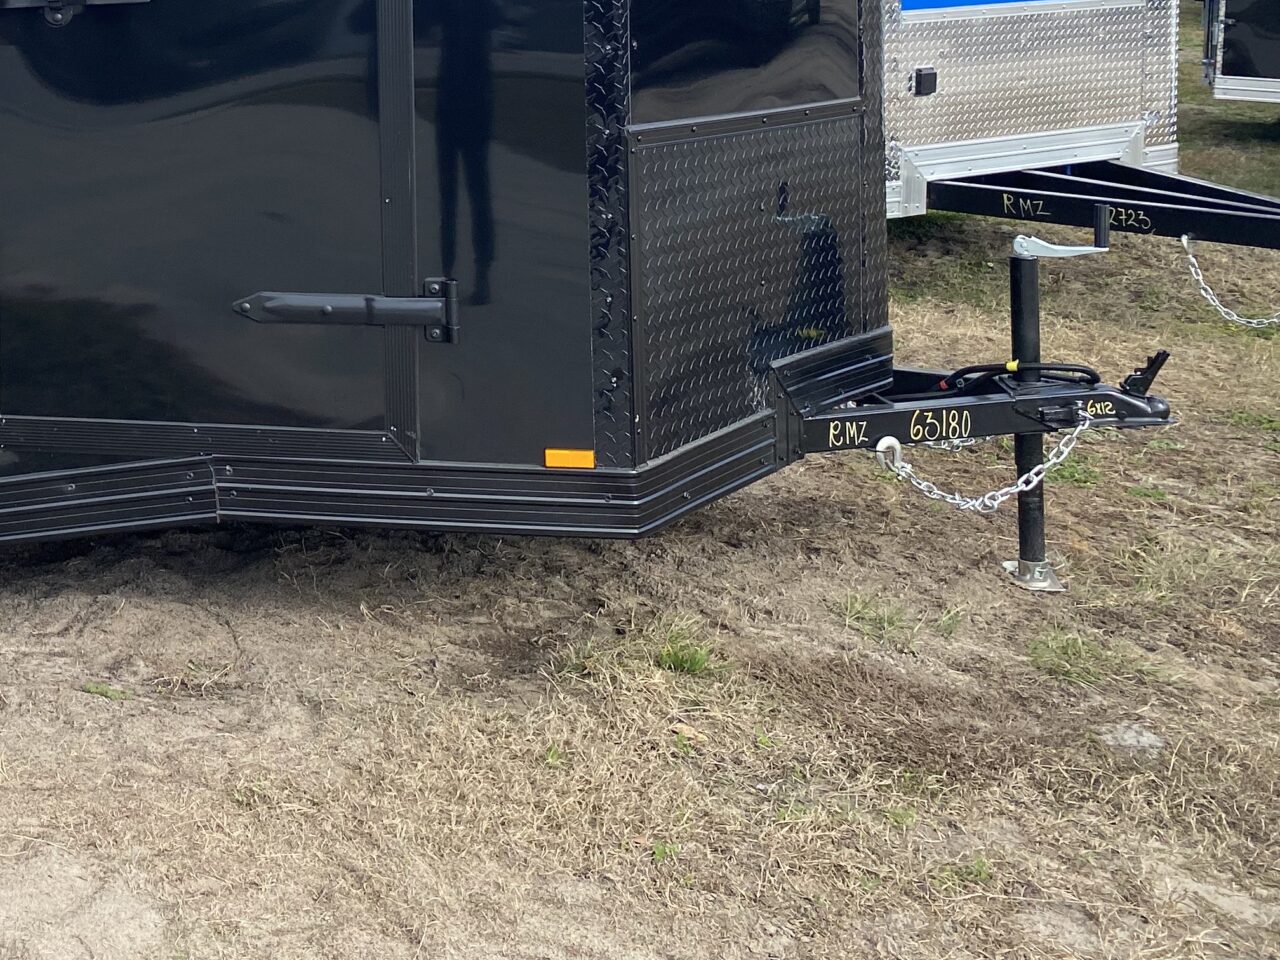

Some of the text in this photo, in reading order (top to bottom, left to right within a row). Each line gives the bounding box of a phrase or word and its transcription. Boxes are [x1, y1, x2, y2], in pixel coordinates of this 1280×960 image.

[1003, 193, 1051, 217] RMZ
[829, 420, 869, 448] RMZ
[910, 409, 971, 441] 63180
